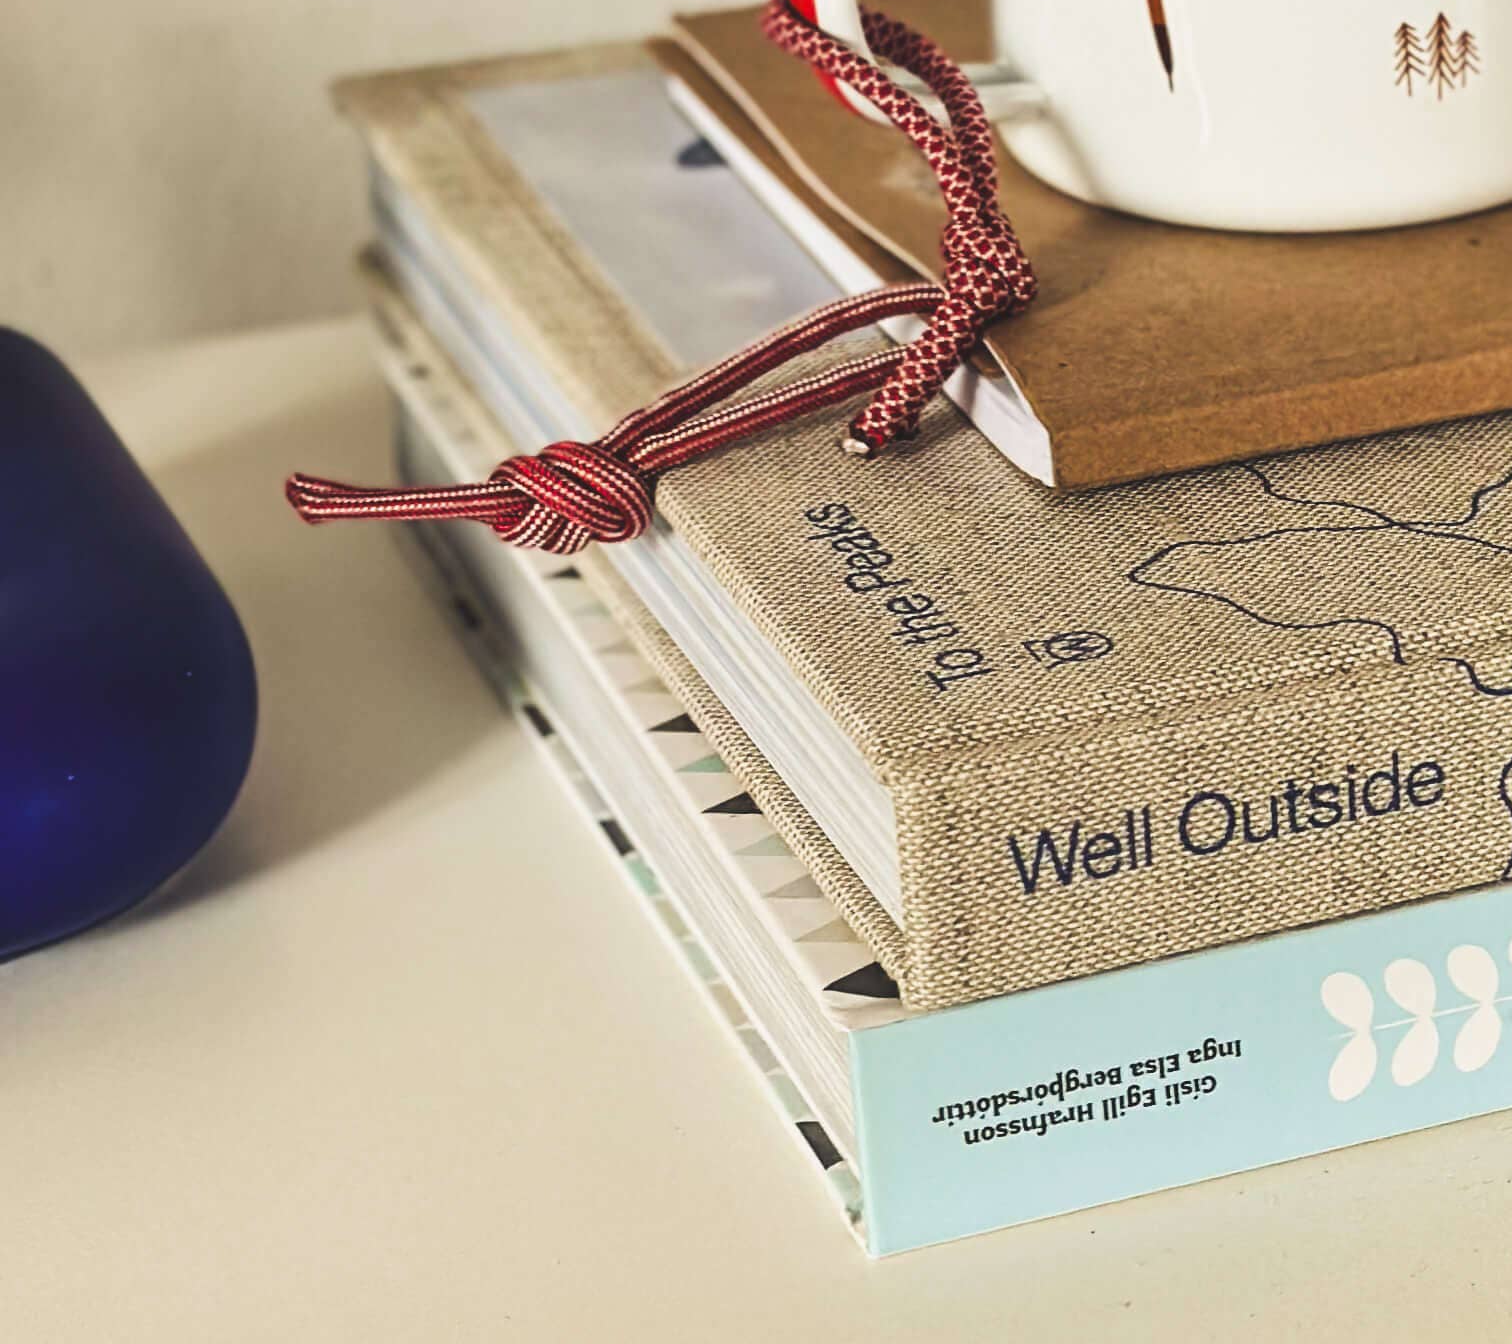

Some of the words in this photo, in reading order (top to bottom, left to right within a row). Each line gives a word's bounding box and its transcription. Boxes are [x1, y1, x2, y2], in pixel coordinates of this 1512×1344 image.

[804, 503, 912, 593] Peaks
[887, 593, 959, 645] the
[926, 649, 995, 692] To
[1007, 807, 1154, 895] Well
[1180, 752, 1445, 856] Outside
[1130, 1053, 1180, 1079] Elsa
[1188, 1038, 1242, 1065] Inga
[1103, 1084, 1157, 1121] Egill
[963, 1103, 1094, 1145] Hrafnsson
